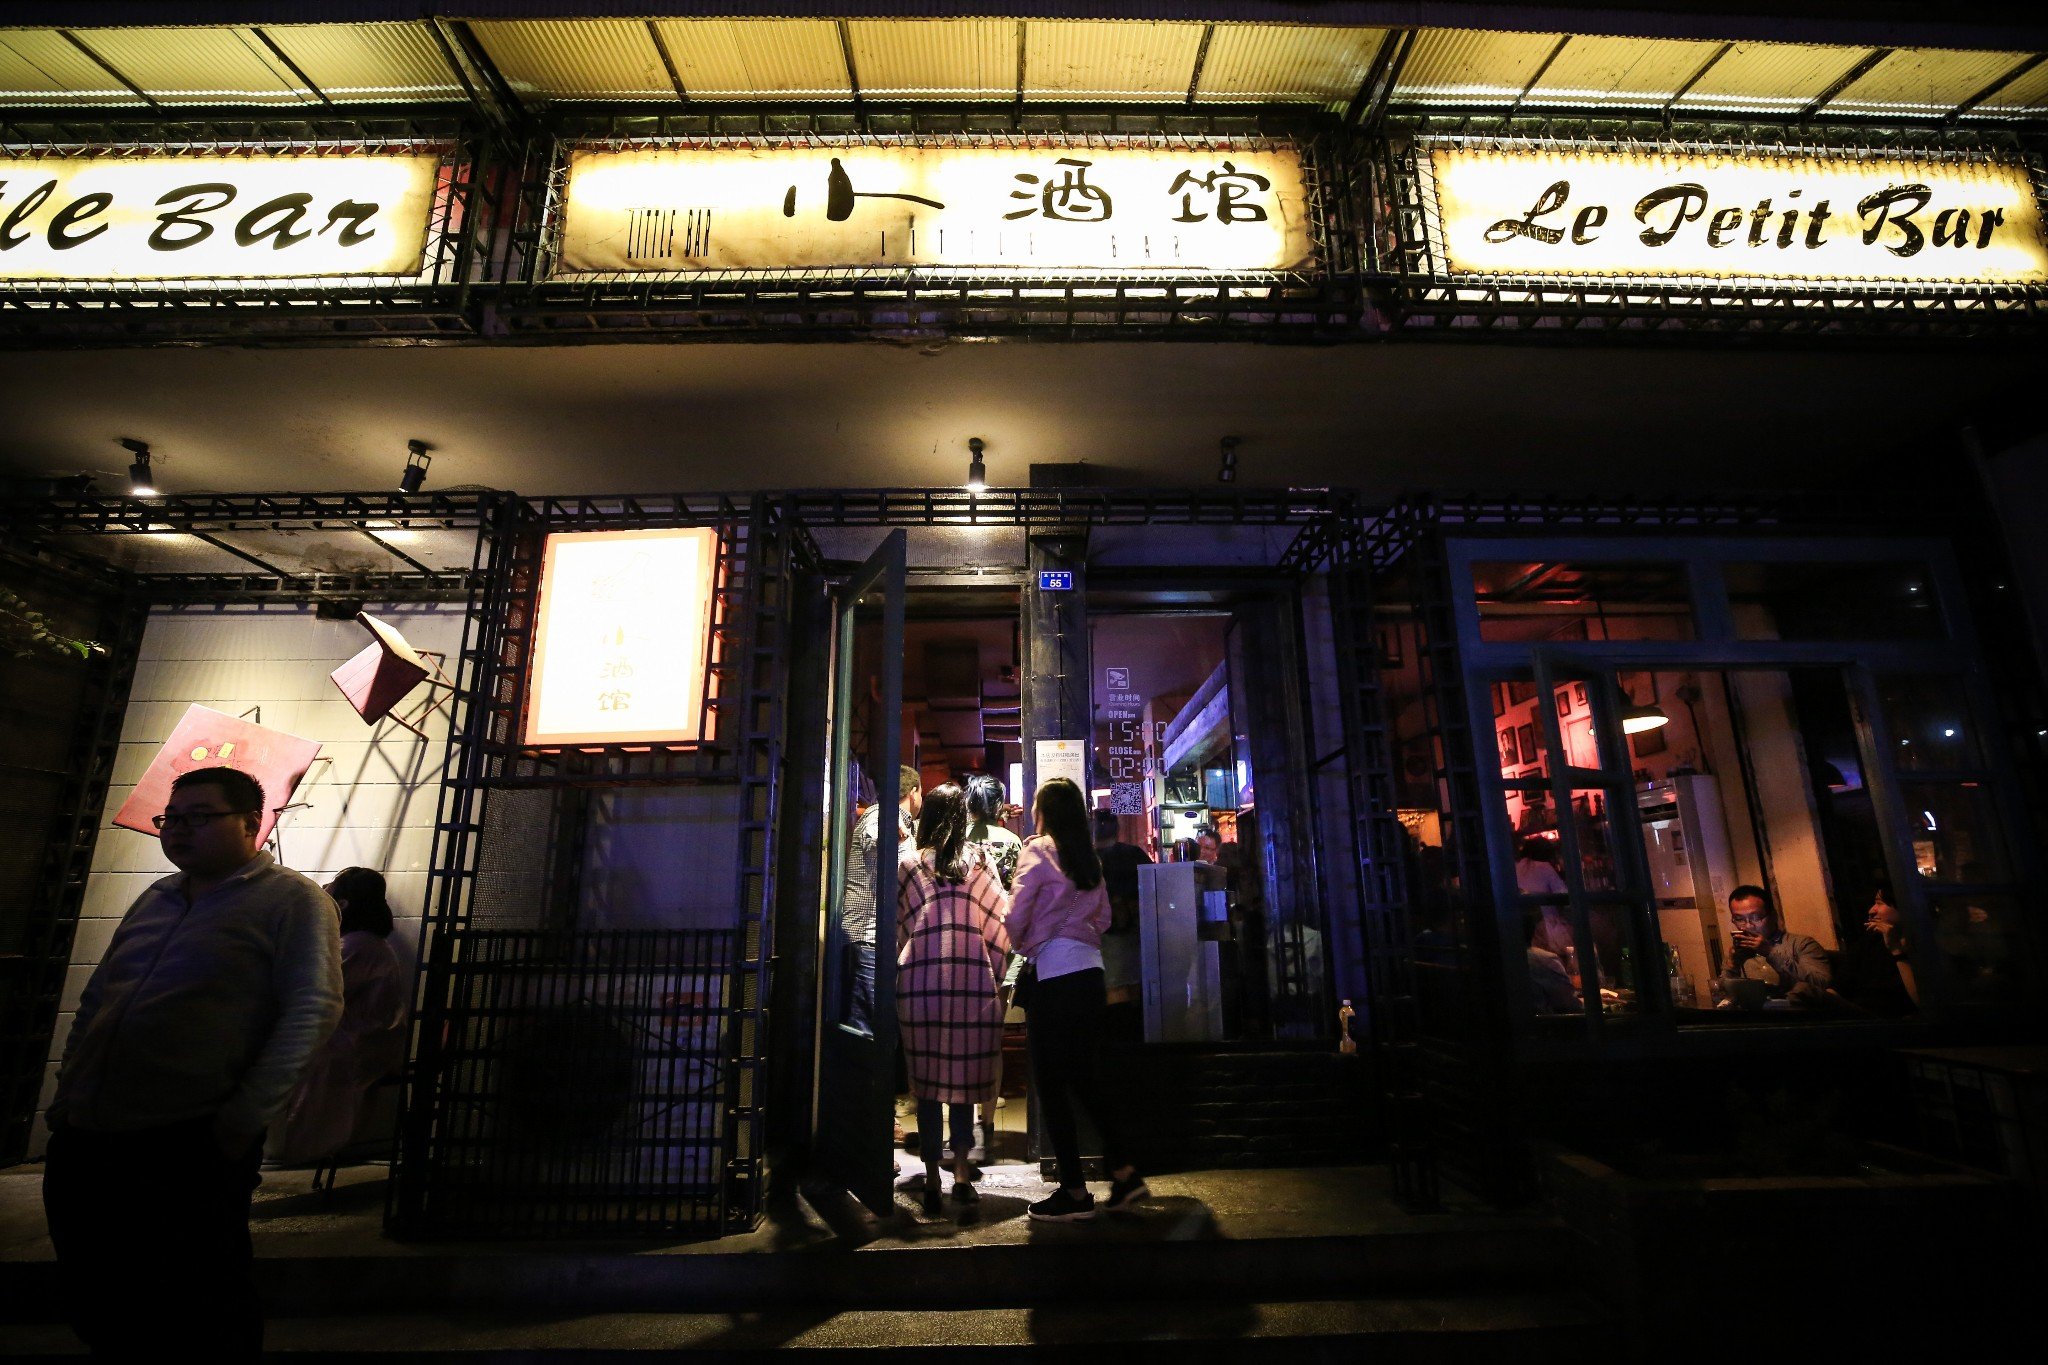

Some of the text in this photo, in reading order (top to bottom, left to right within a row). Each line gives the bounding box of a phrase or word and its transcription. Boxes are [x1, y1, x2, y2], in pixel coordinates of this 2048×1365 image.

[784, 156, 1267, 224] 小酒馆
[0, 179, 379, 251] le Bar
[1481, 180, 2004, 257] Le Petit Bar
[1050, 579, 1062, 587] 55
[1109, 721, 1168, 741] 15:00
[1110, 758, 1170, 778] 02:00
